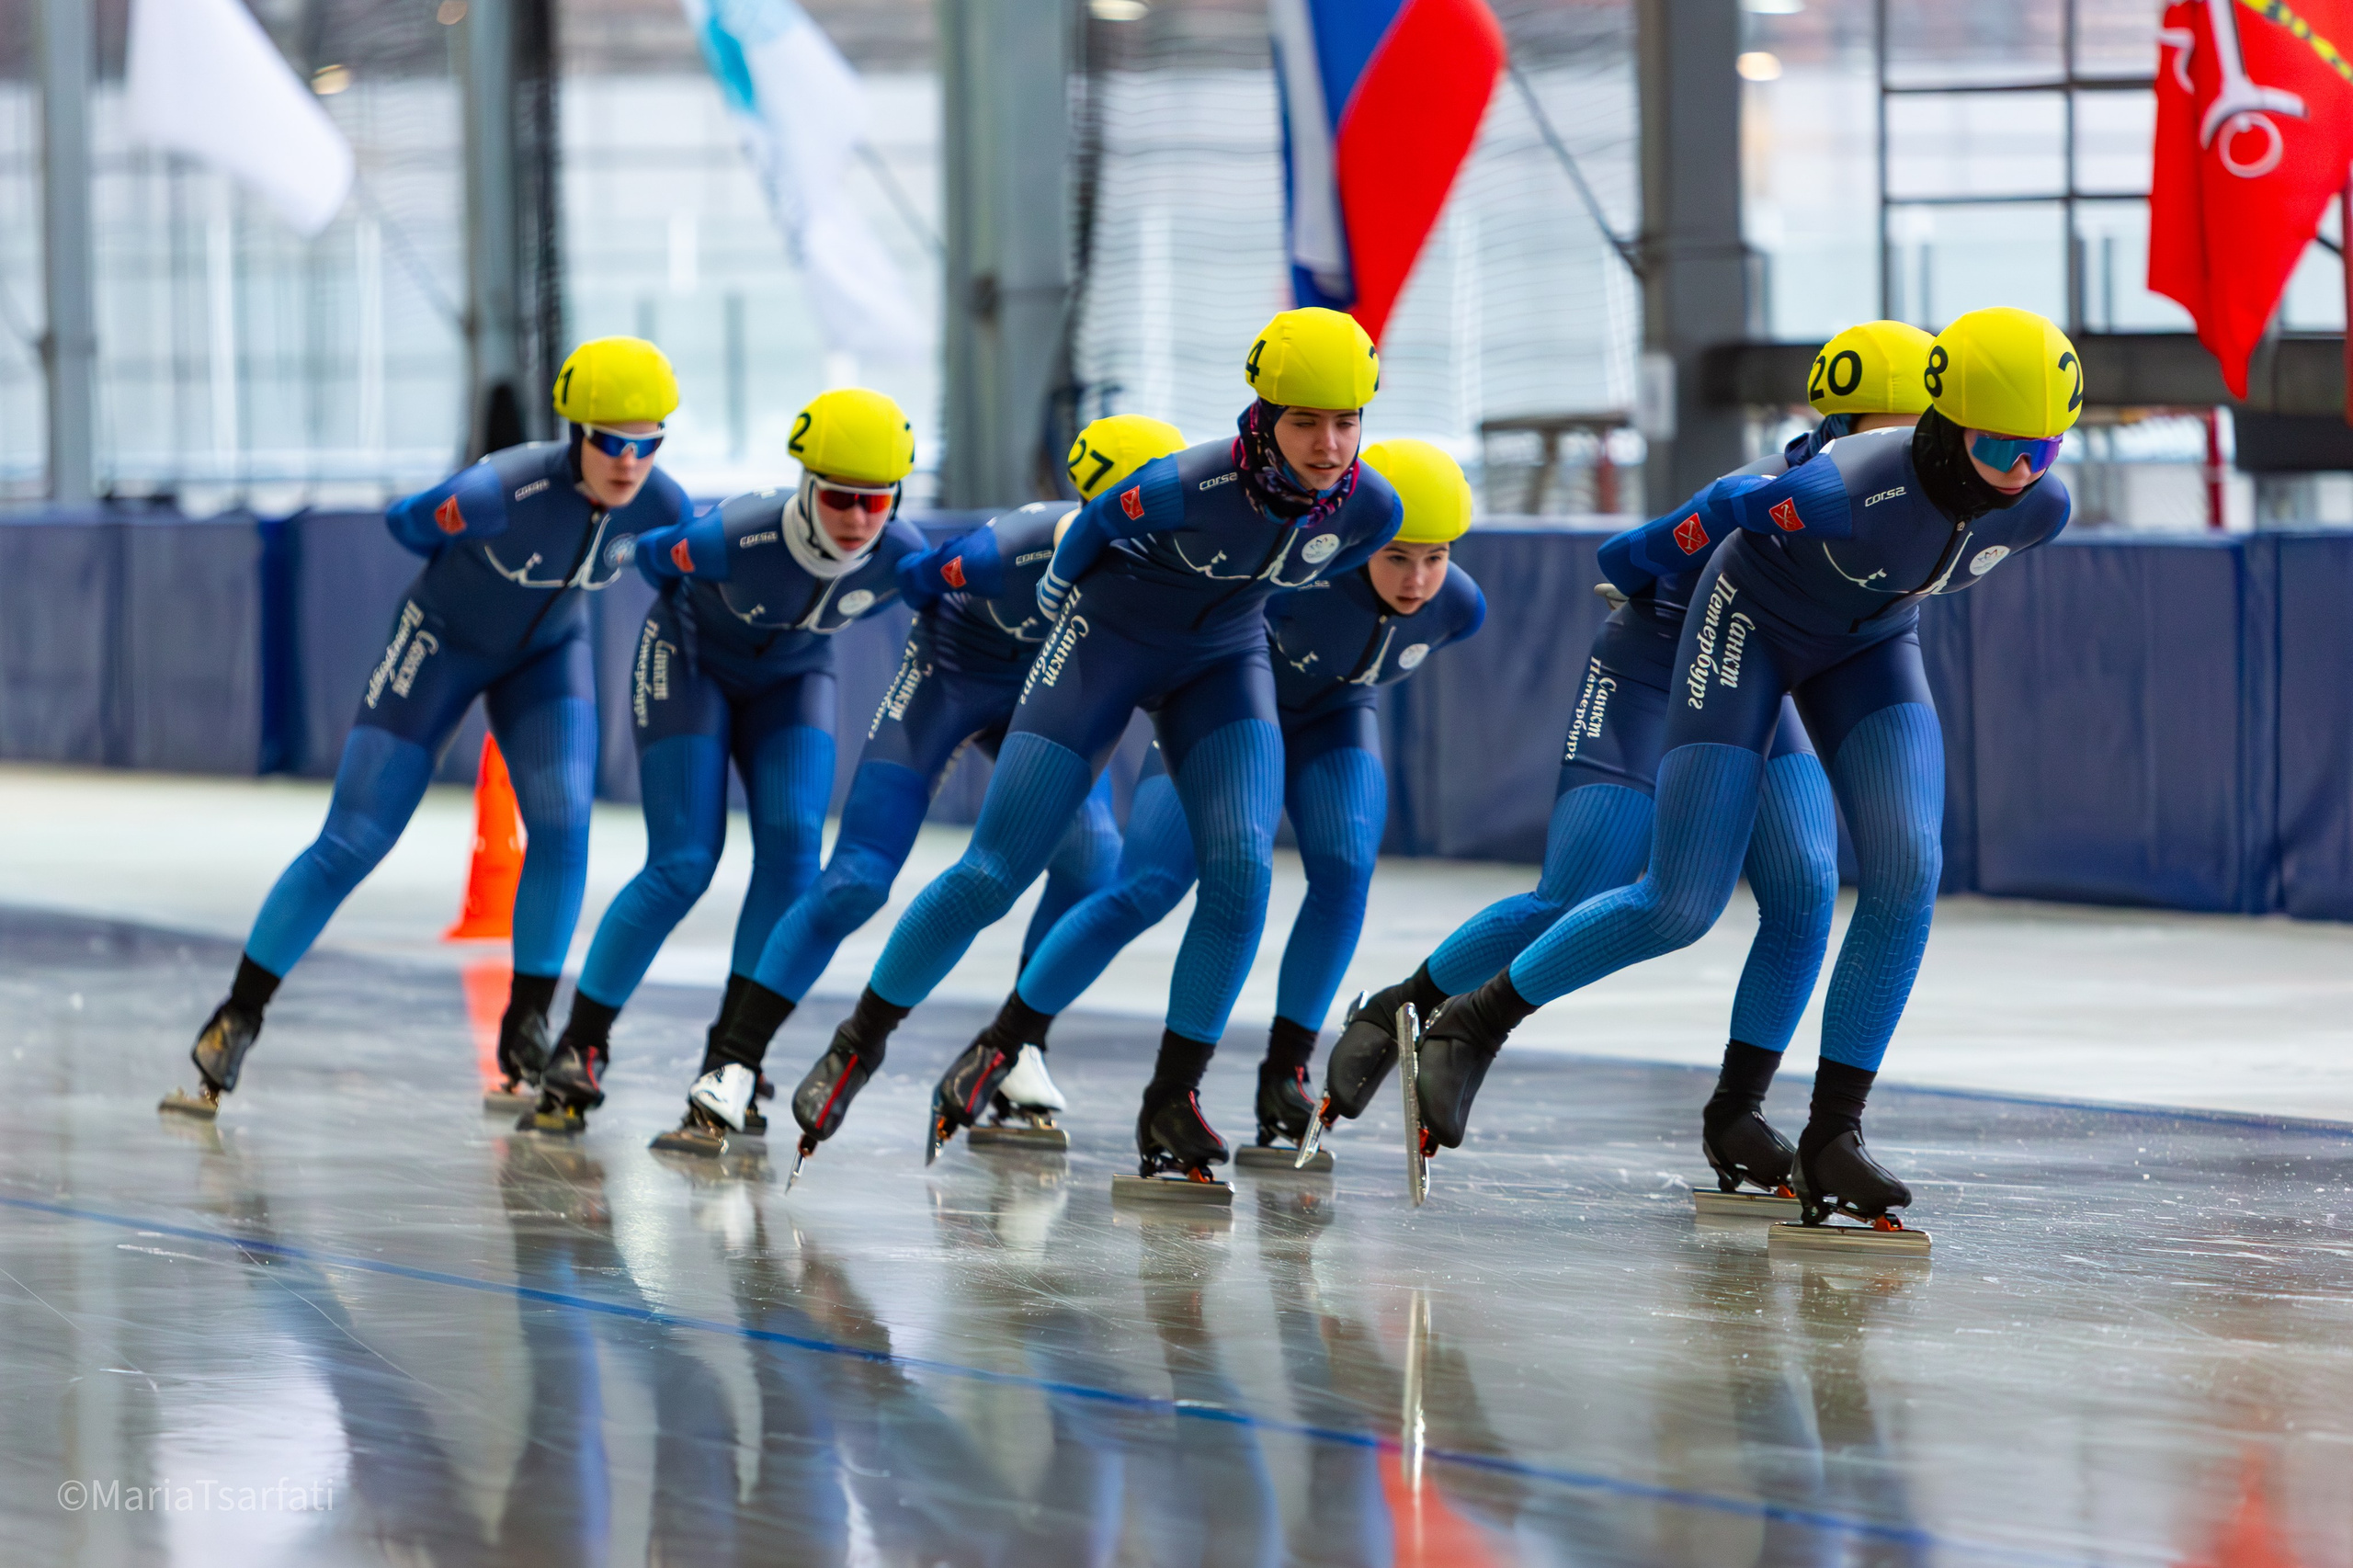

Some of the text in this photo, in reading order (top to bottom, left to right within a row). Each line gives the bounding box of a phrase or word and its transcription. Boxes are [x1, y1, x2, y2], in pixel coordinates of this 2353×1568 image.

[1245, 339, 1267, 384] 4
[1810, 349, 1863, 403] 20
[1924, 346, 1949, 398] 8
[2058, 351, 2085, 414] 2
[788, 411, 812, 453] 2
[1066, 437, 1115, 493] 27
[1199, 472, 1238, 492] corsa
[1864, 486, 1907, 507] corsa
[1687, 572, 1739, 710] Петербург
[1719, 611, 1756, 688] Санкт
[1586, 676, 1618, 739] Санкт
